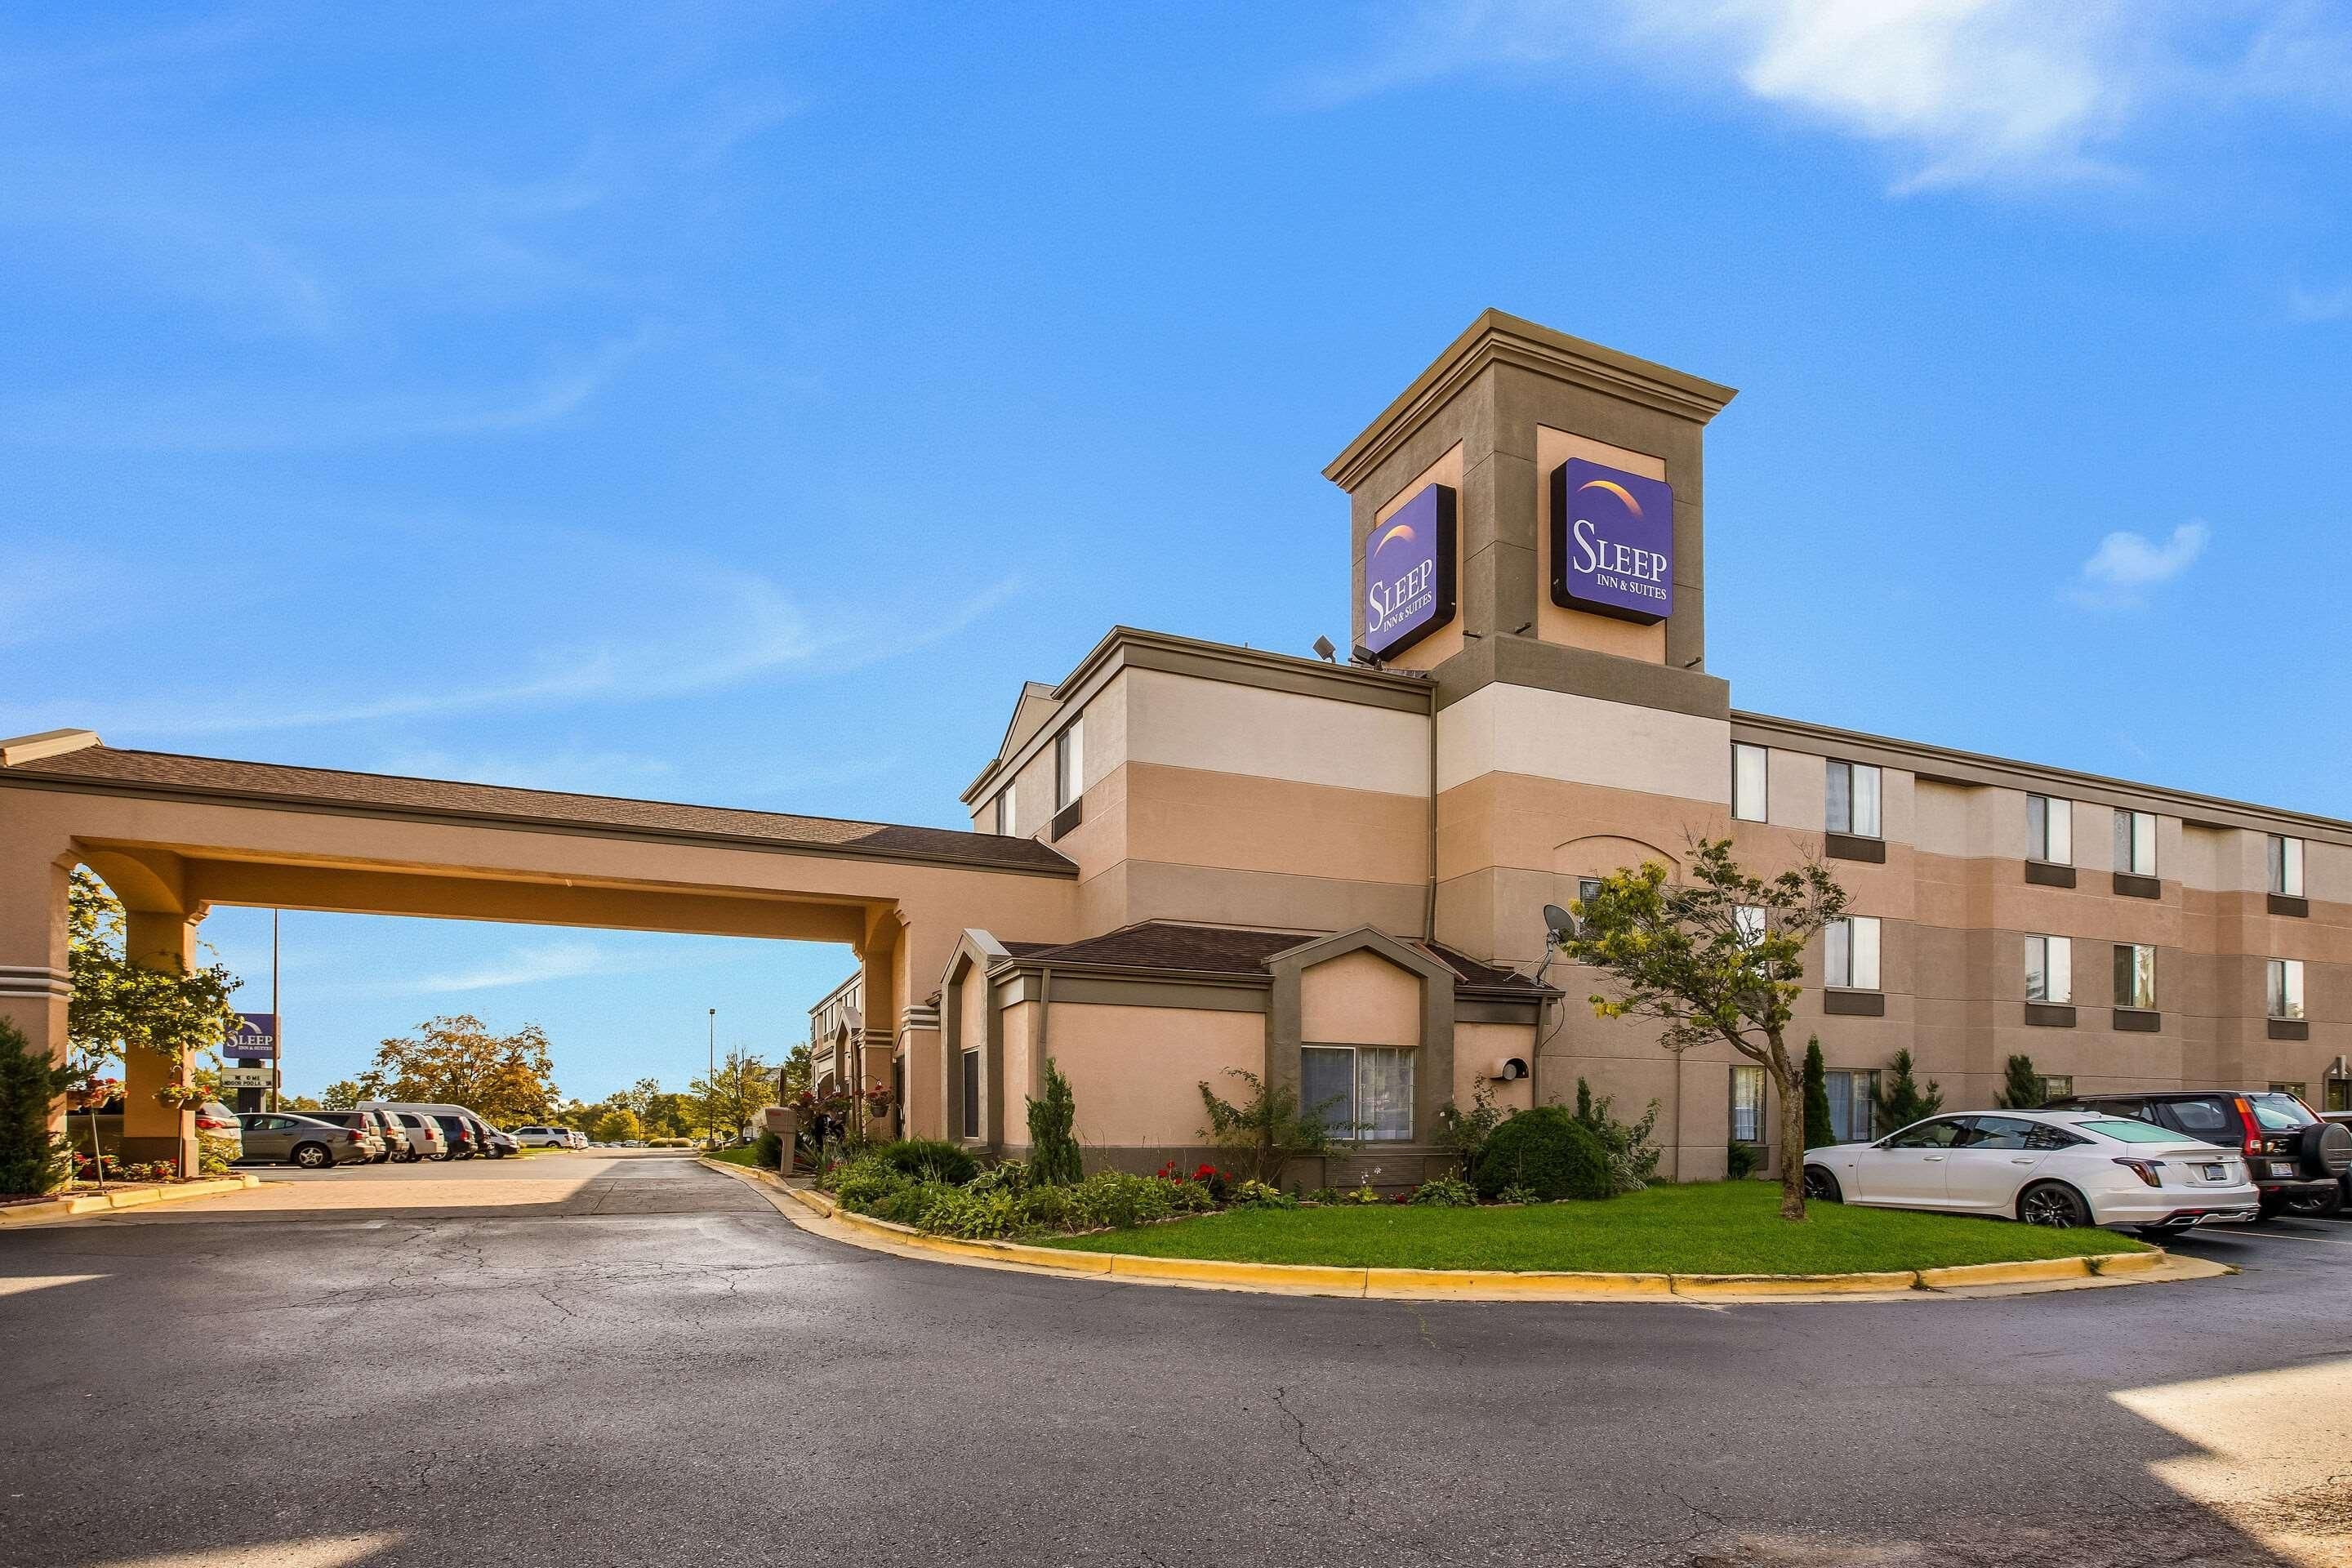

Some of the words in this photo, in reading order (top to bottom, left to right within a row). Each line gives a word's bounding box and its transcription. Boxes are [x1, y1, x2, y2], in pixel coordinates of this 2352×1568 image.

[1573, 519, 1668, 582] SLEEP
[1369, 559, 1432, 634] SLEEP
[1597, 573, 1619, 588] INN
[1619, 580, 1628, 591] &
[1629, 581, 1667, 600] SUITES
[1383, 614, 1399, 633] INN
[1398, 611, 1405, 621] &
[1405, 590, 1432, 617] SUITES
[226, 1030, 273, 1047] SLEEP
